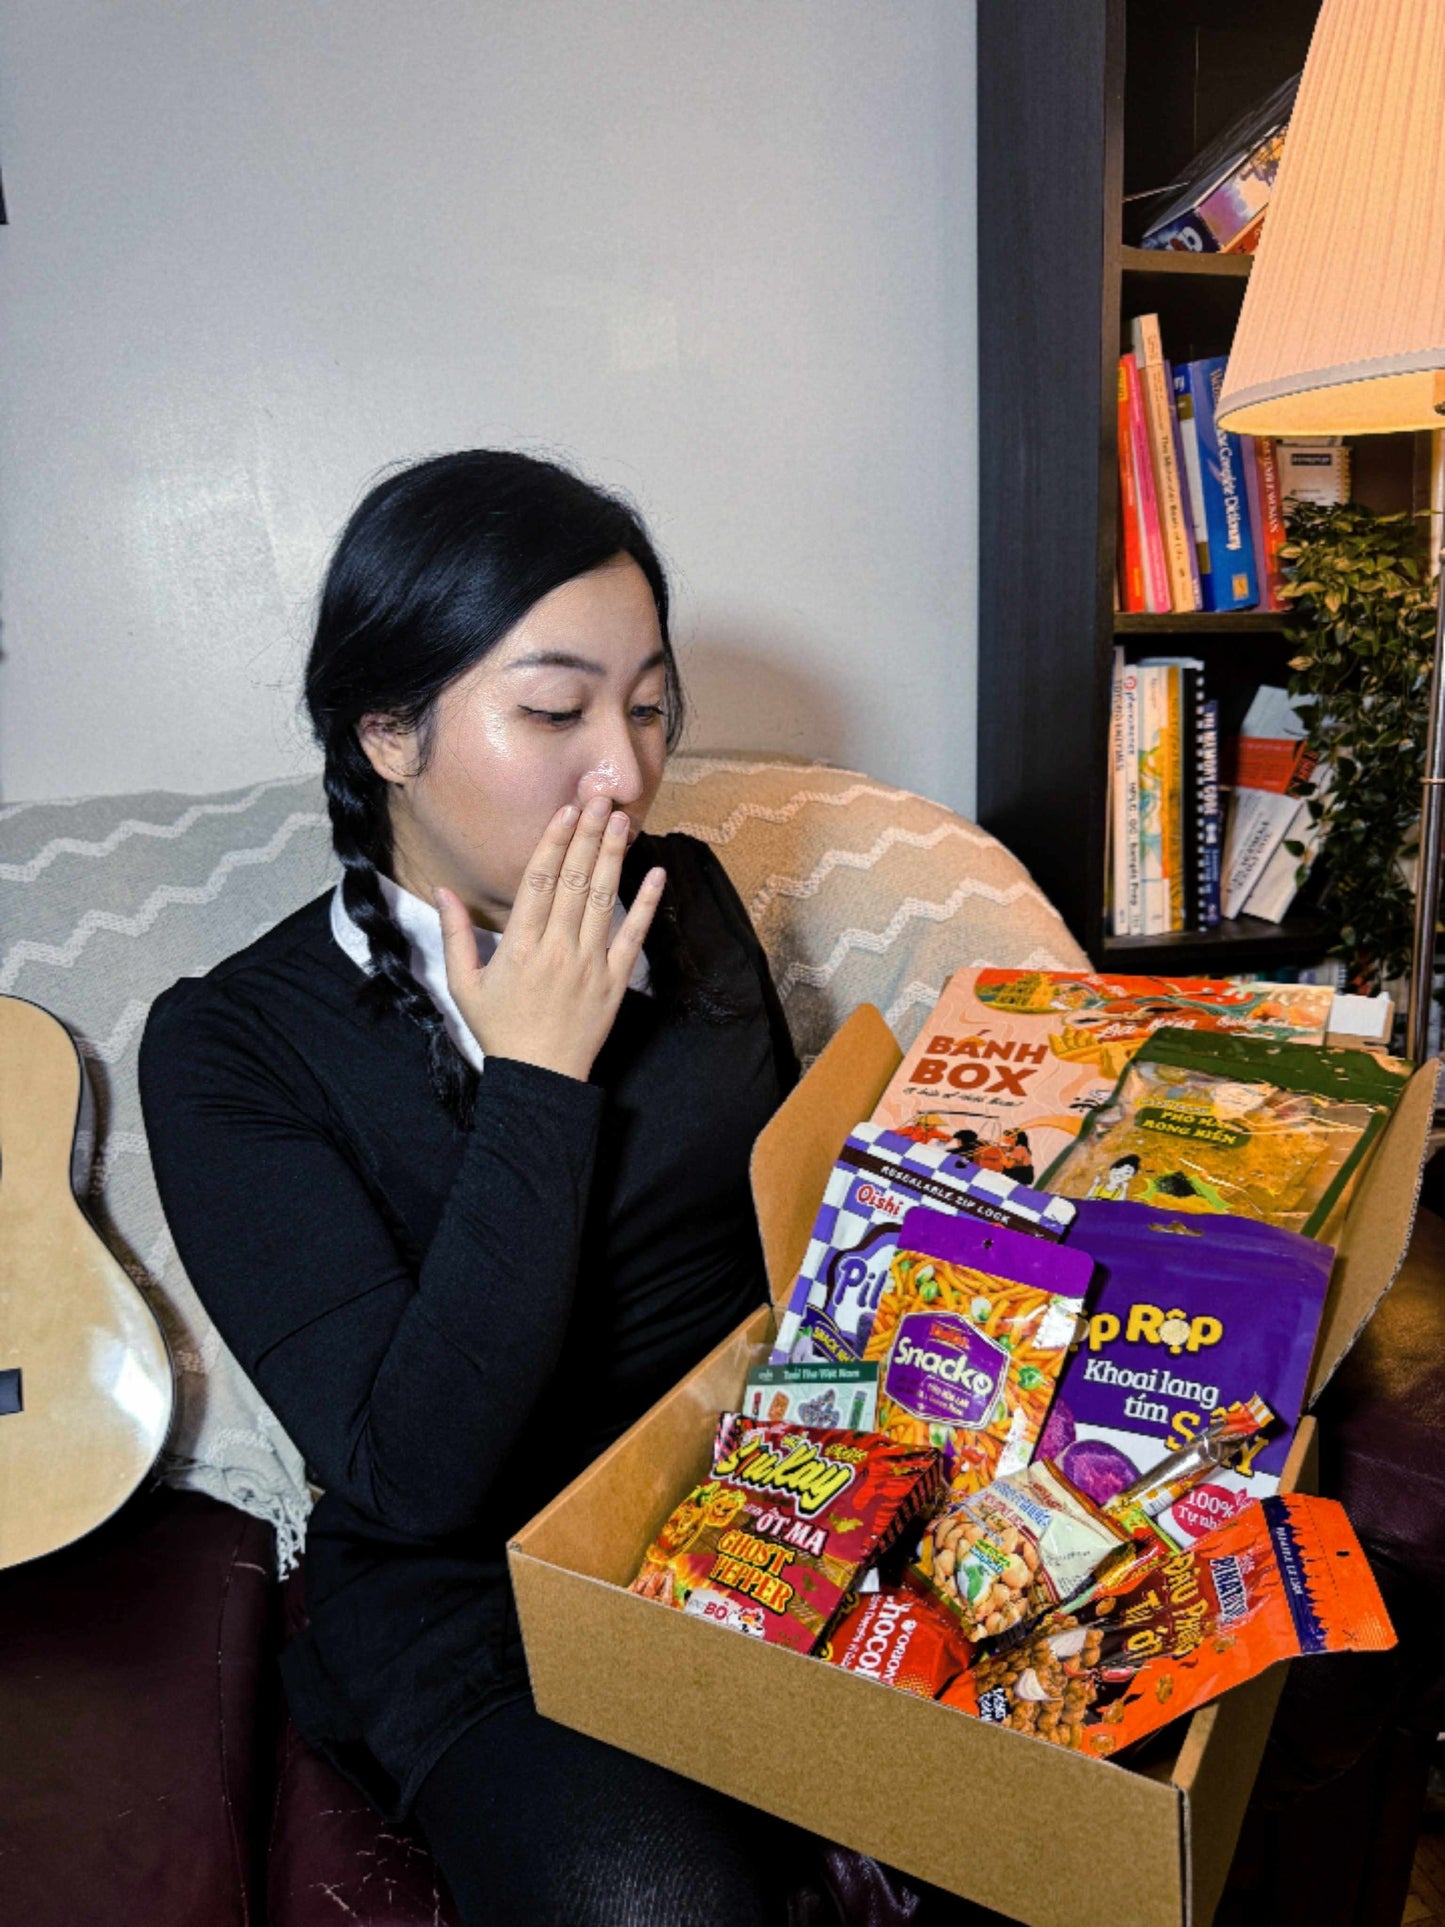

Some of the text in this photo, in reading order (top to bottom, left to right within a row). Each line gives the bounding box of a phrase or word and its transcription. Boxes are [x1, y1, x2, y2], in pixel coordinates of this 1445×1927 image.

[1224, 496, 1242, 550] Dictionary
[1204, 785, 1217, 816] CODE
[925, 1029, 1049, 1064] BÁNH
[909, 1057, 1038, 1097] BOX
[857, 1183, 904, 1216] Oishi
[880, 1164, 1010, 1225] RESEALABLE ZIP LOCK
[833, 1256, 888, 1310] Pil
[1083, 1358, 1220, 1410] Khoai lang
[1123, 1393, 1170, 1425] tím
[1177, 1505, 1199, 1526] Tự
[1186, 1491, 1235, 1518] 100%
[718, 1529, 795, 1576] GHOST
[784, 1520, 828, 1556] MA
[710, 1553, 794, 1613] PEPPER
[882, 1632, 910, 1685] ORION
